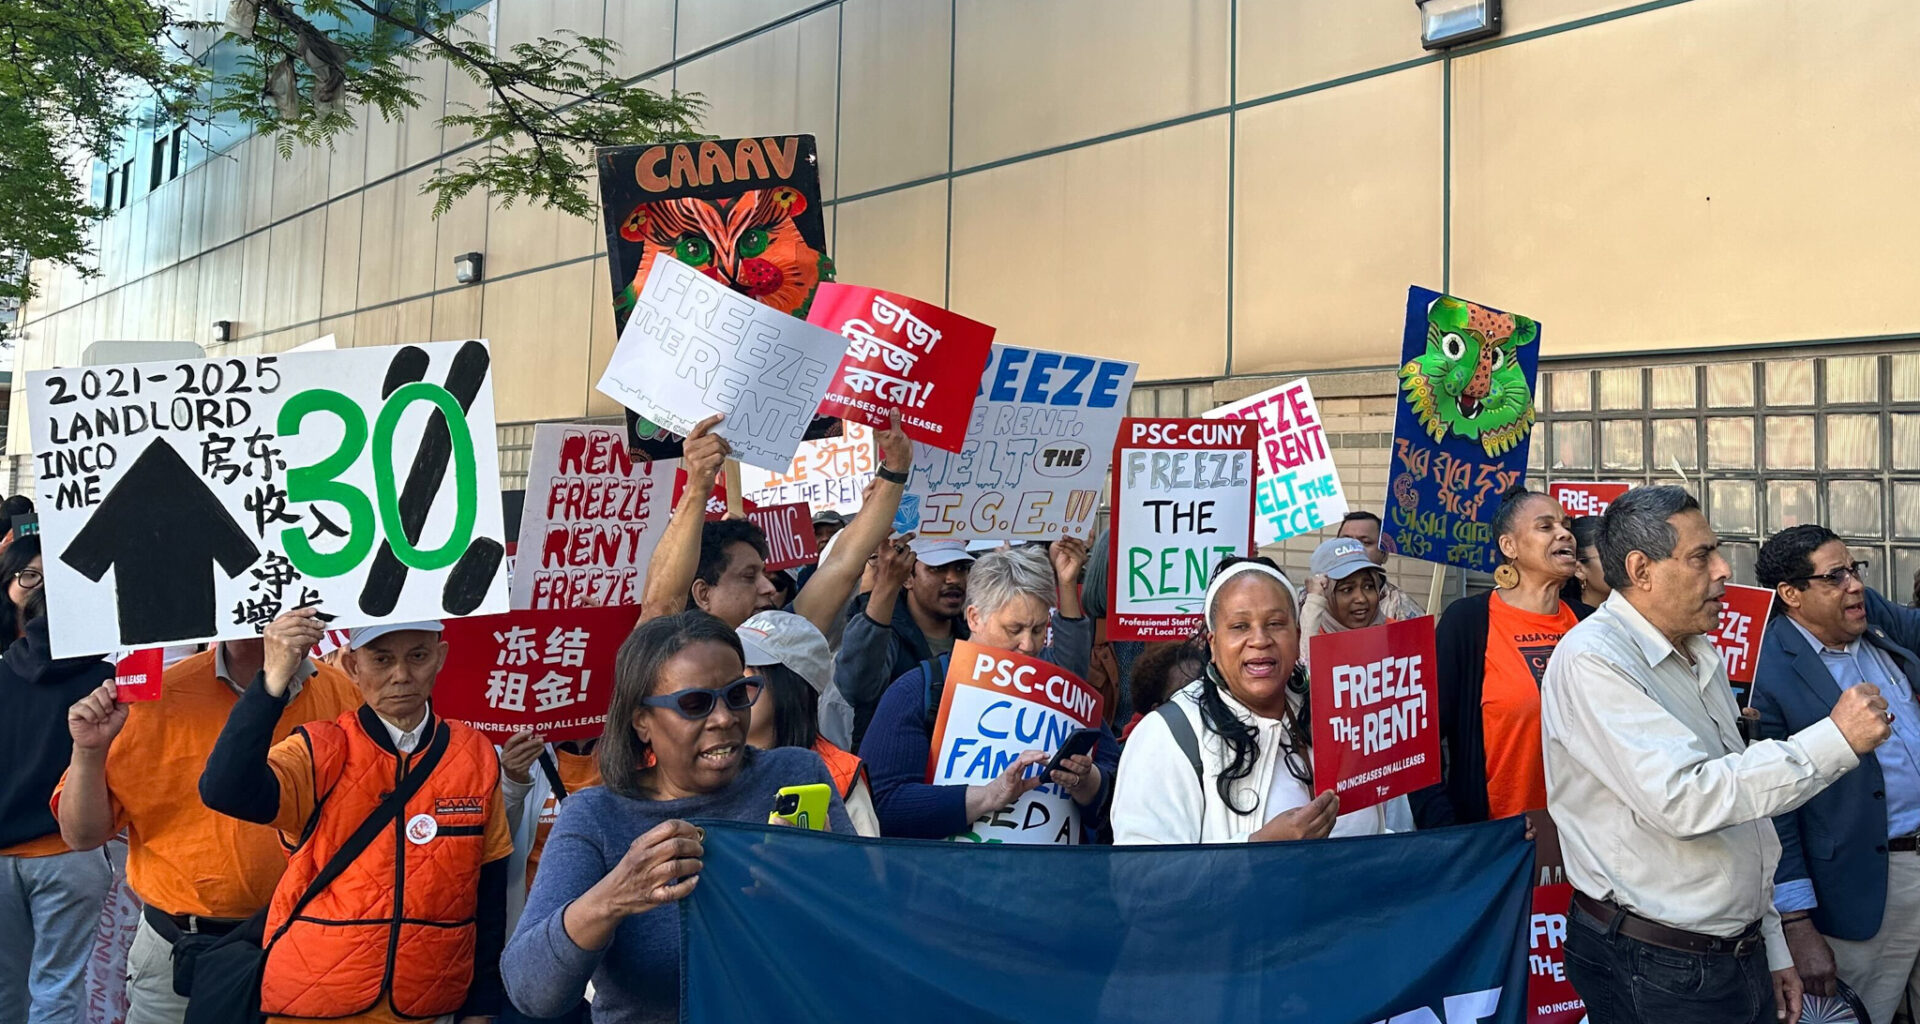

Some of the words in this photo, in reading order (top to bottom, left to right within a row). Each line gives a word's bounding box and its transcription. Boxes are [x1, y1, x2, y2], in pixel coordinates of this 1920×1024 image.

[634, 137, 799, 193] CAAAV
[651, 258, 828, 403] FREEZE
[840, 317, 919, 378] ফ্রিজ
[871, 294, 943, 354] ভাড়া
[44, 356, 281, 405] 2021-2025
[634, 304, 685, 358] THE
[676, 335, 818, 442] RENT!
[843, 365, 935, 409] করো!
[976, 347, 1129, 408] EEZE
[49, 396, 252, 446] LANDLORD
[823, 392, 876, 413] NCREASES
[908, 417, 944, 434] LEASES
[1130, 423, 1247, 445] PSC-CUNY
[37, 441, 117, 480] INCO
[199, 426, 288, 485] 房东
[558, 429, 653, 478] REN
[904, 438, 1038, 491] MELT
[1043, 448, 1086, 468] THE
[1127, 450, 1248, 493] FREEZE
[1264, 424, 1327, 475] RENT
[547, 476, 654, 522] FREEZE
[793, 481, 821, 503] THE
[825, 471, 875, 504] RENT
[1256, 470, 1298, 517] ELT
[1299, 473, 1338, 501] THE
[1558, 488, 1609, 517] FREEZ
[243, 483, 350, 540] 收入
[919, 489, 1098, 535] I.C.E.!!
[1143, 499, 1218, 535] THE
[1268, 501, 1325, 543] ICE
[542, 521, 648, 569] RENT
[749, 506, 819, 565] HING...
[249, 549, 302, 601] 净
[530, 566, 638, 611] FREEZE
[1118, 617, 1170, 628] Professional
[1171, 616, 1191, 628] Staff
[1137, 627, 1153, 637] AFT
[1154, 627, 1176, 637] Local
[493, 625, 591, 668] 冻结
[485, 669, 592, 713] 租金!
[971, 652, 1097, 723] PSC-CUNY
[1332, 654, 1423, 709] FREEZE
[473, 721, 534, 732] INCREASES
[535, 721, 553, 731] ON
[554, 718, 574, 730] ALL
[575, 714, 608, 727] LEASE
[977, 700, 1076, 752] CUN
[1329, 715, 1361, 751] THE
[1363, 689, 1428, 757] RENT!
[1336, 780, 1347, 793] NO
[1347, 765, 1383, 789] INCREASES
[1382, 762, 1392, 778] ON
[1391, 759, 1404, 774] ALL
[1402, 752, 1426, 772] LEASES
[1529, 954, 1567, 983] THE
[1537, 1002, 1553, 1016] NO
[1552, 998, 1586, 1014] INCREA
